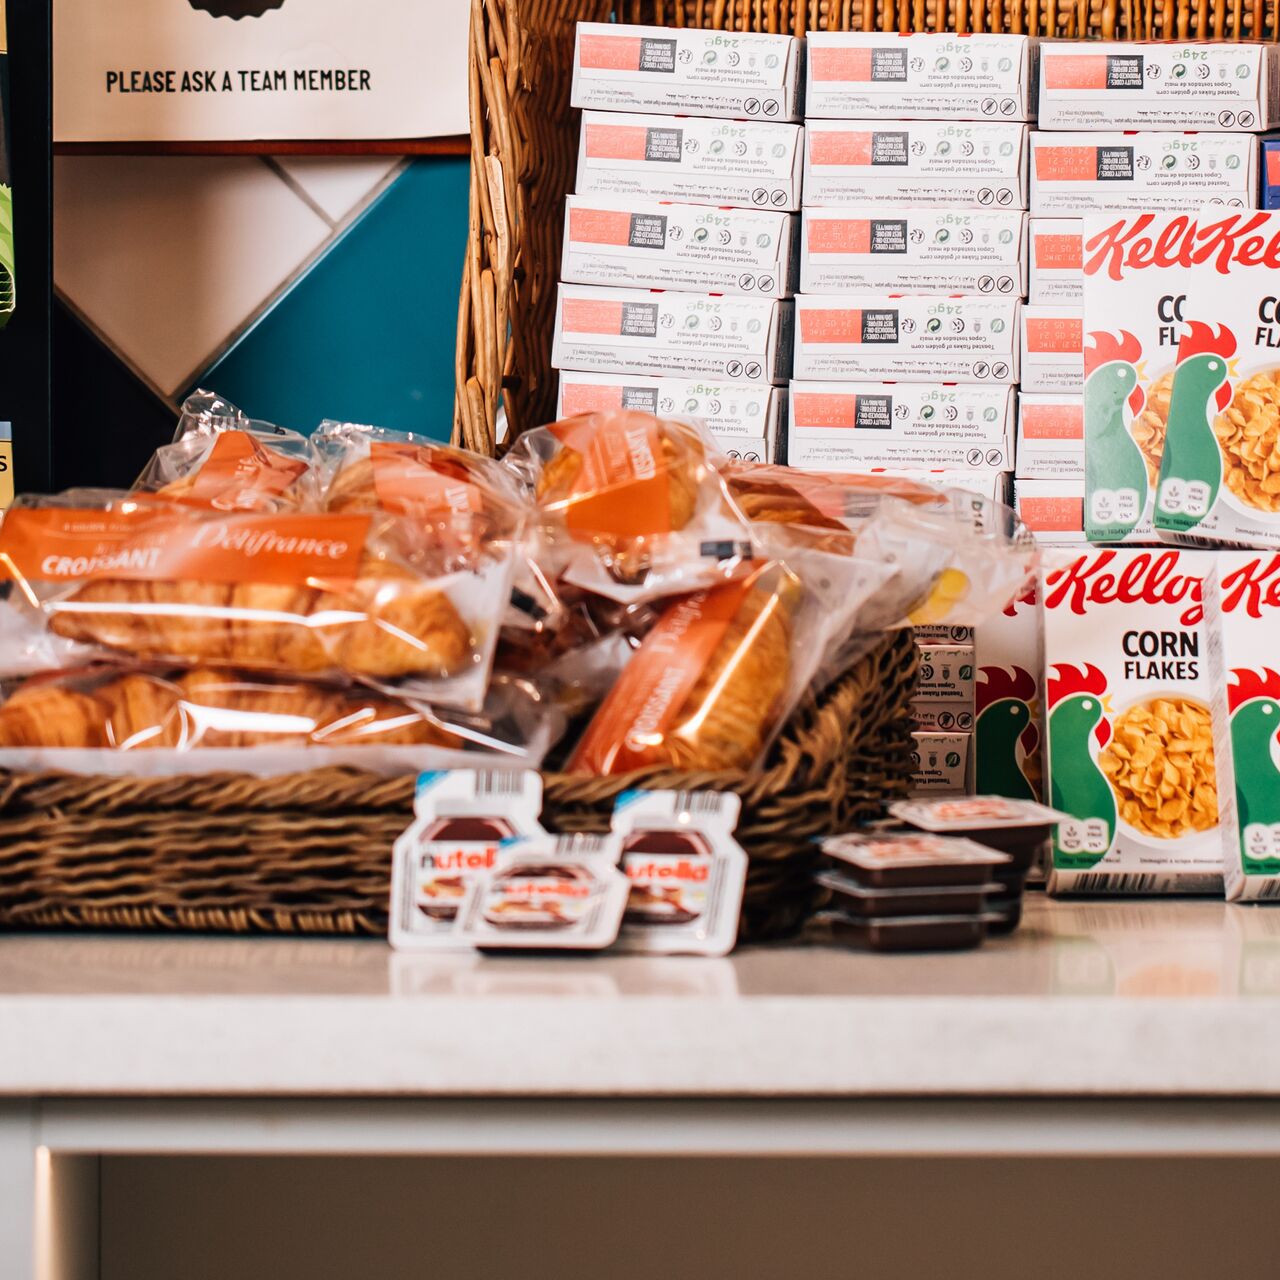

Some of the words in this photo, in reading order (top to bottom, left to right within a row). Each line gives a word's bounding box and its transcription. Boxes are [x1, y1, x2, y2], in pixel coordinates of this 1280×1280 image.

[105, 70, 177, 93] PLEASE
[181, 71, 218, 93] ASK
[221, 71, 233, 93] A
[237, 70, 287, 92] TEAM
[293, 70, 372, 92] MEMBER
[1121, 630, 1200, 659] CORN
[1124, 660, 1200, 681] FLAKES
[627, 861, 708, 882] utella
